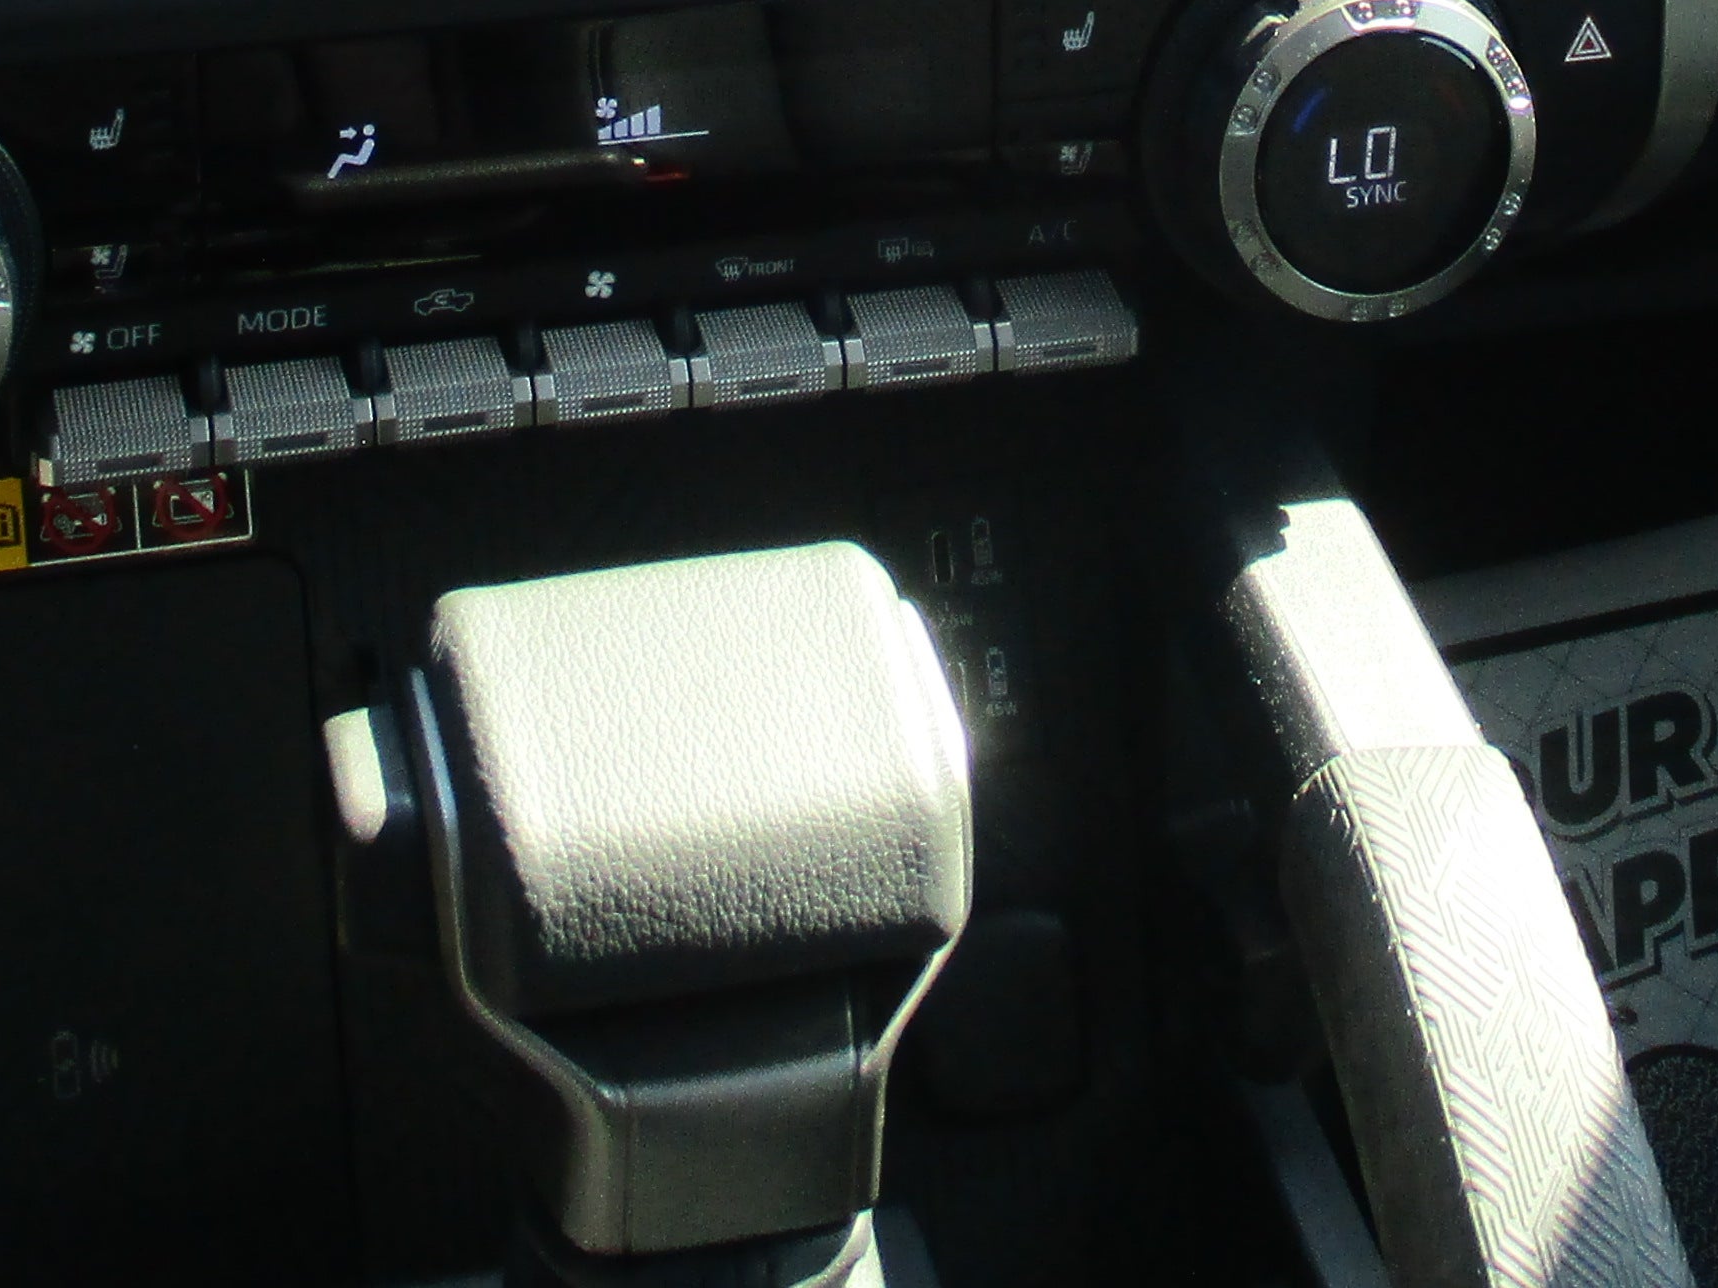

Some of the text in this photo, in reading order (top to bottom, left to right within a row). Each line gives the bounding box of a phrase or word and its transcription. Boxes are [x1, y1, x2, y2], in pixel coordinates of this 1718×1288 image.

[1345, 179, 1408, 209] SYNC
[746, 258, 797, 277] FRONT
[237, 304, 329, 335] MODE
[106, 323, 163, 351] OFF
[1507, 690, 1707, 826] UR
